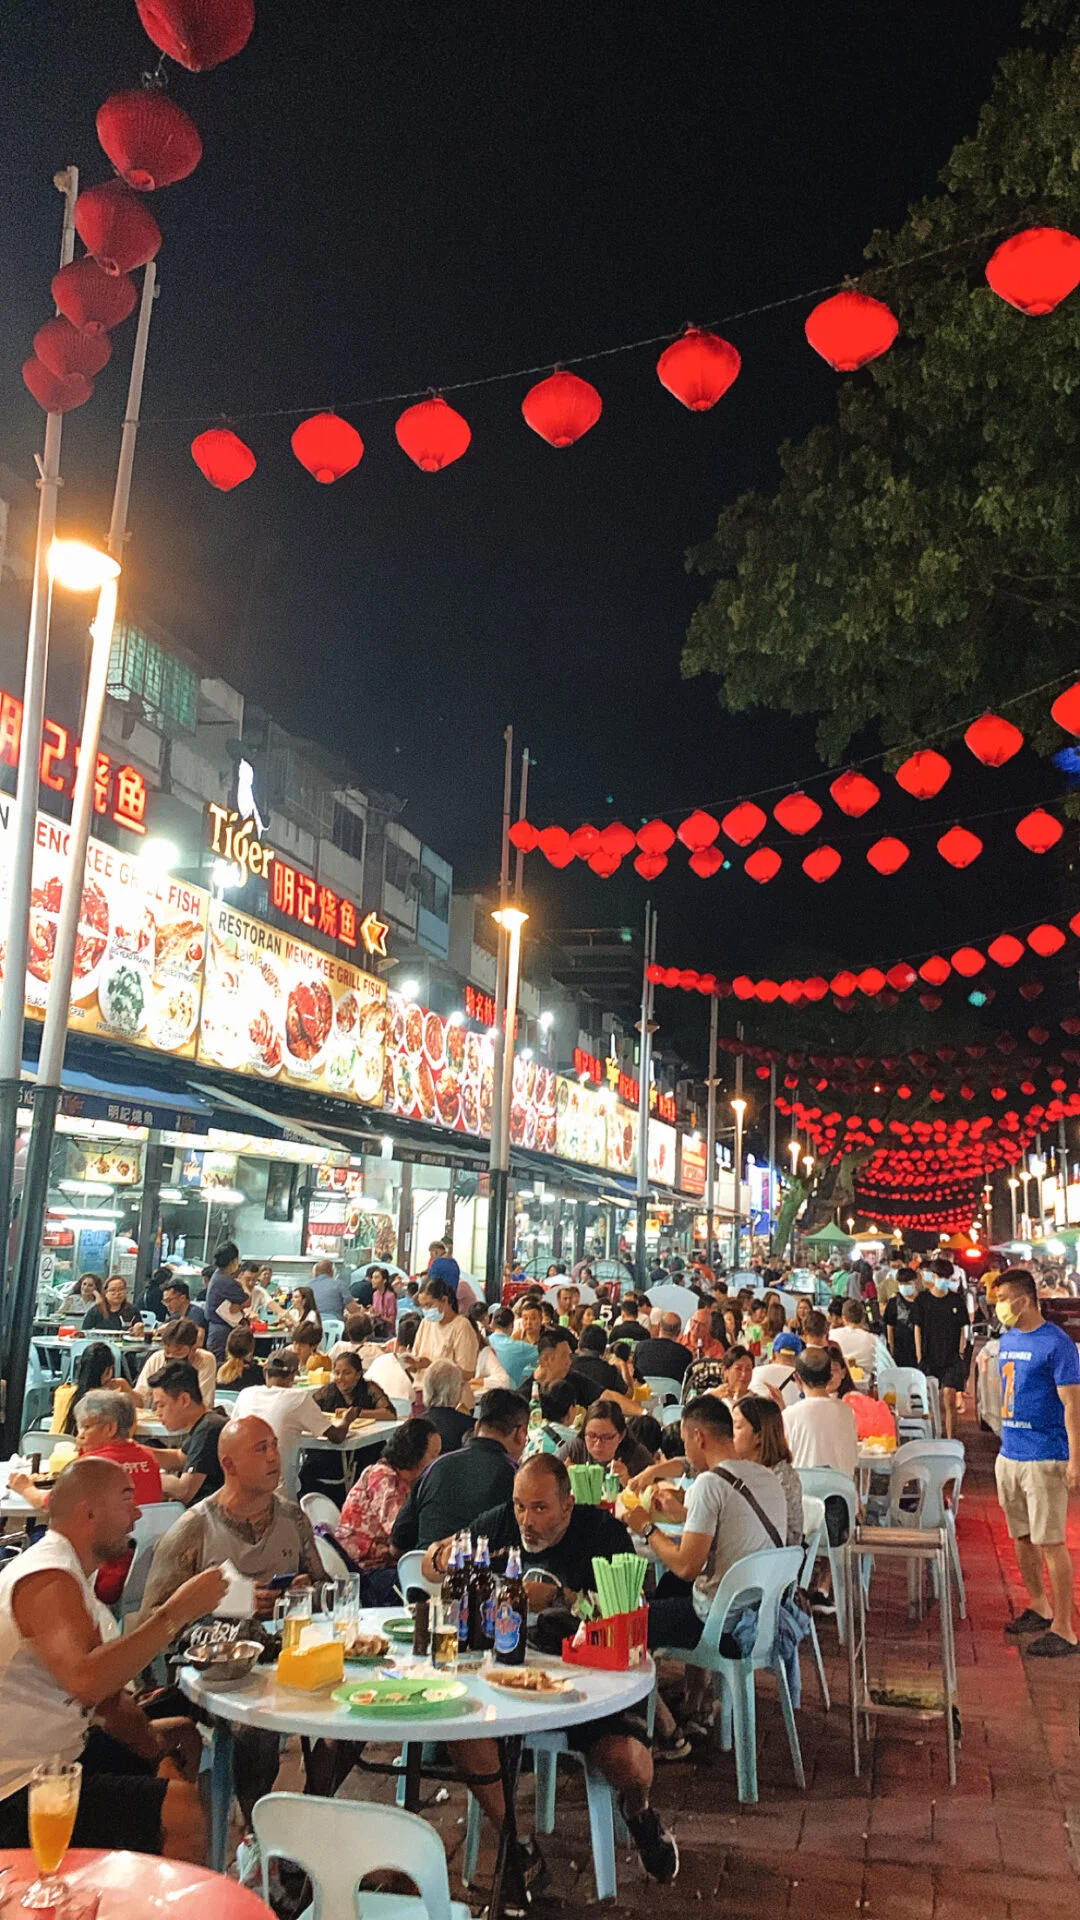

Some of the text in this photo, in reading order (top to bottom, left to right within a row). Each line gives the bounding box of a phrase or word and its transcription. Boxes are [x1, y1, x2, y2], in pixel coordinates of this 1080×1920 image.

[208, 802, 275, 888] Tiger
[168, 884, 200, 917] FISH
[218, 911, 382, 999] RESTORAN MENG KEE GRILL FISH
[600, 1304, 612, 1323] 5
